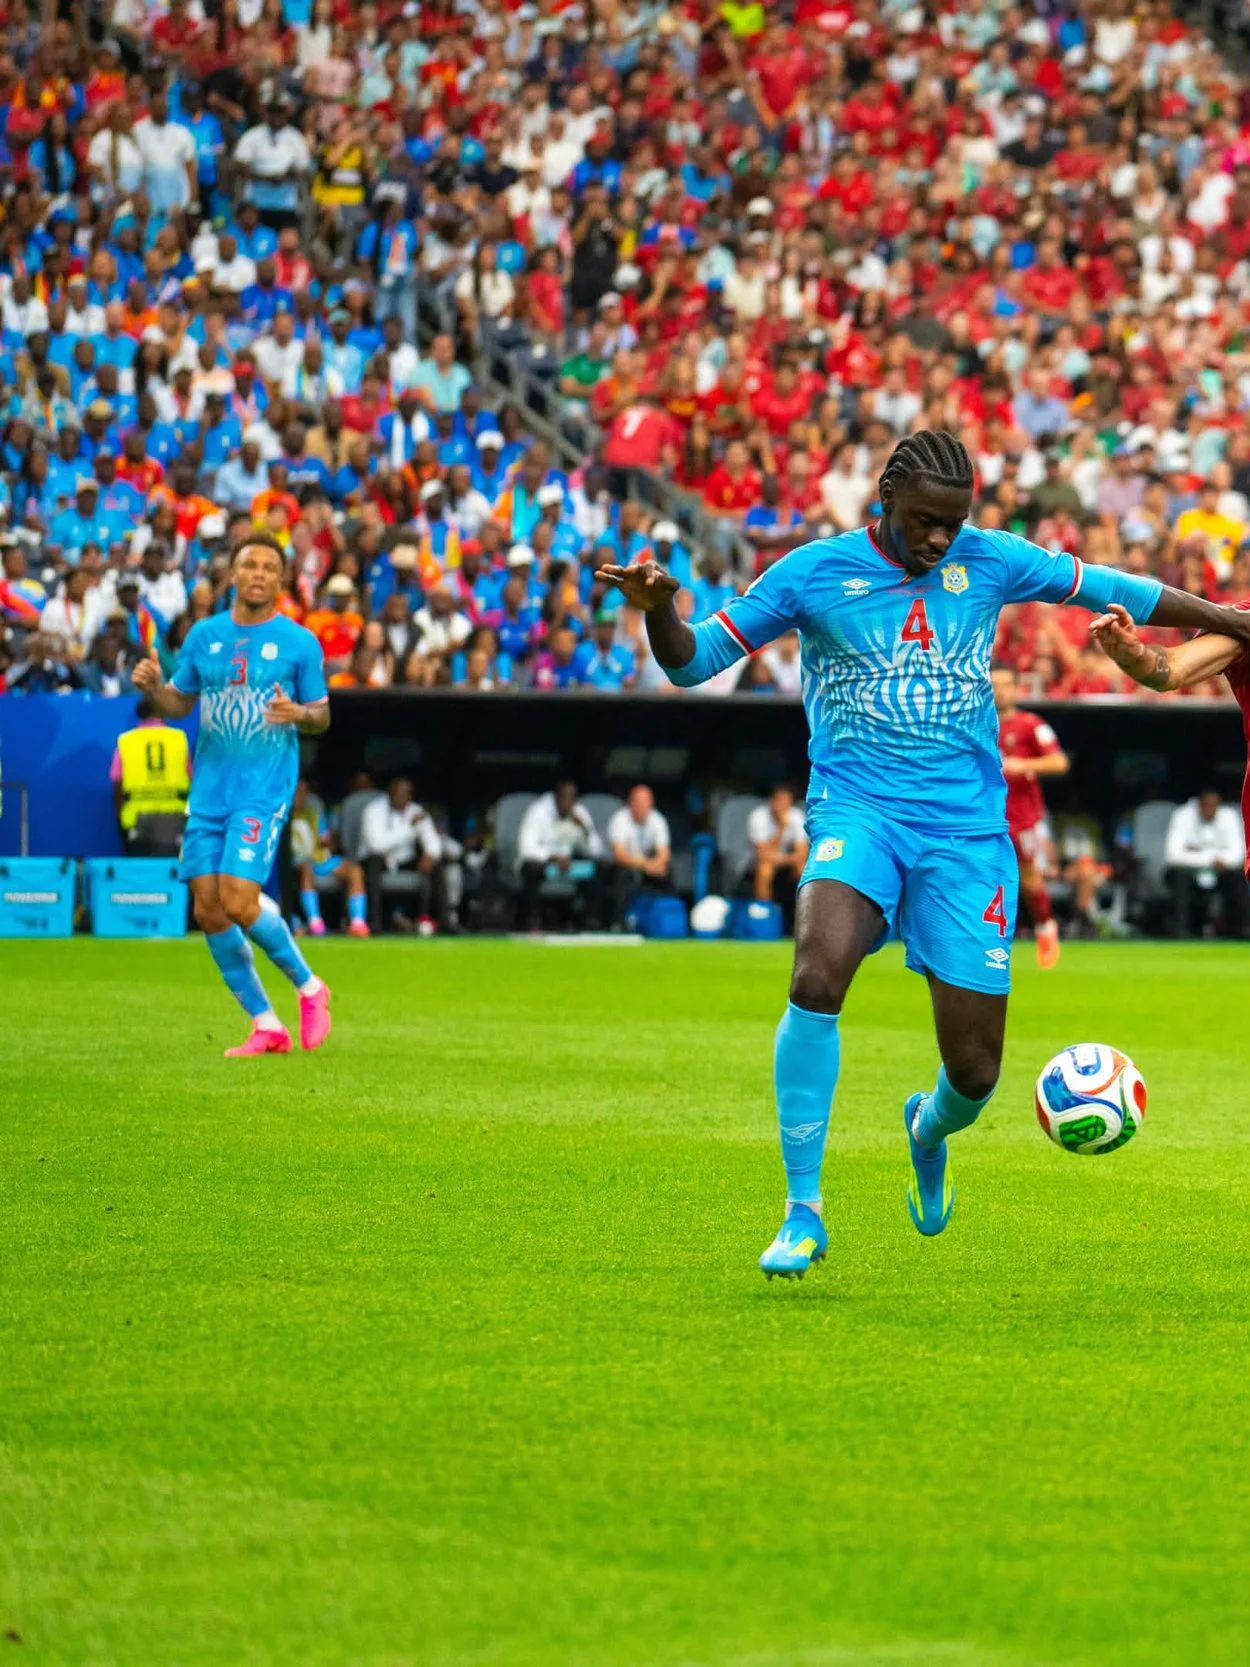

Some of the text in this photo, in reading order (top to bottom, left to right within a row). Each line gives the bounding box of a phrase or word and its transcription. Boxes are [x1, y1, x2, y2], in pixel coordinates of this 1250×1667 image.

[843, 589, 870, 597] umbro
[901, 598, 934, 650] 4
[230, 657, 248, 685] 3
[241, 816, 262, 844] 3
[982, 884, 1008, 937] 4
